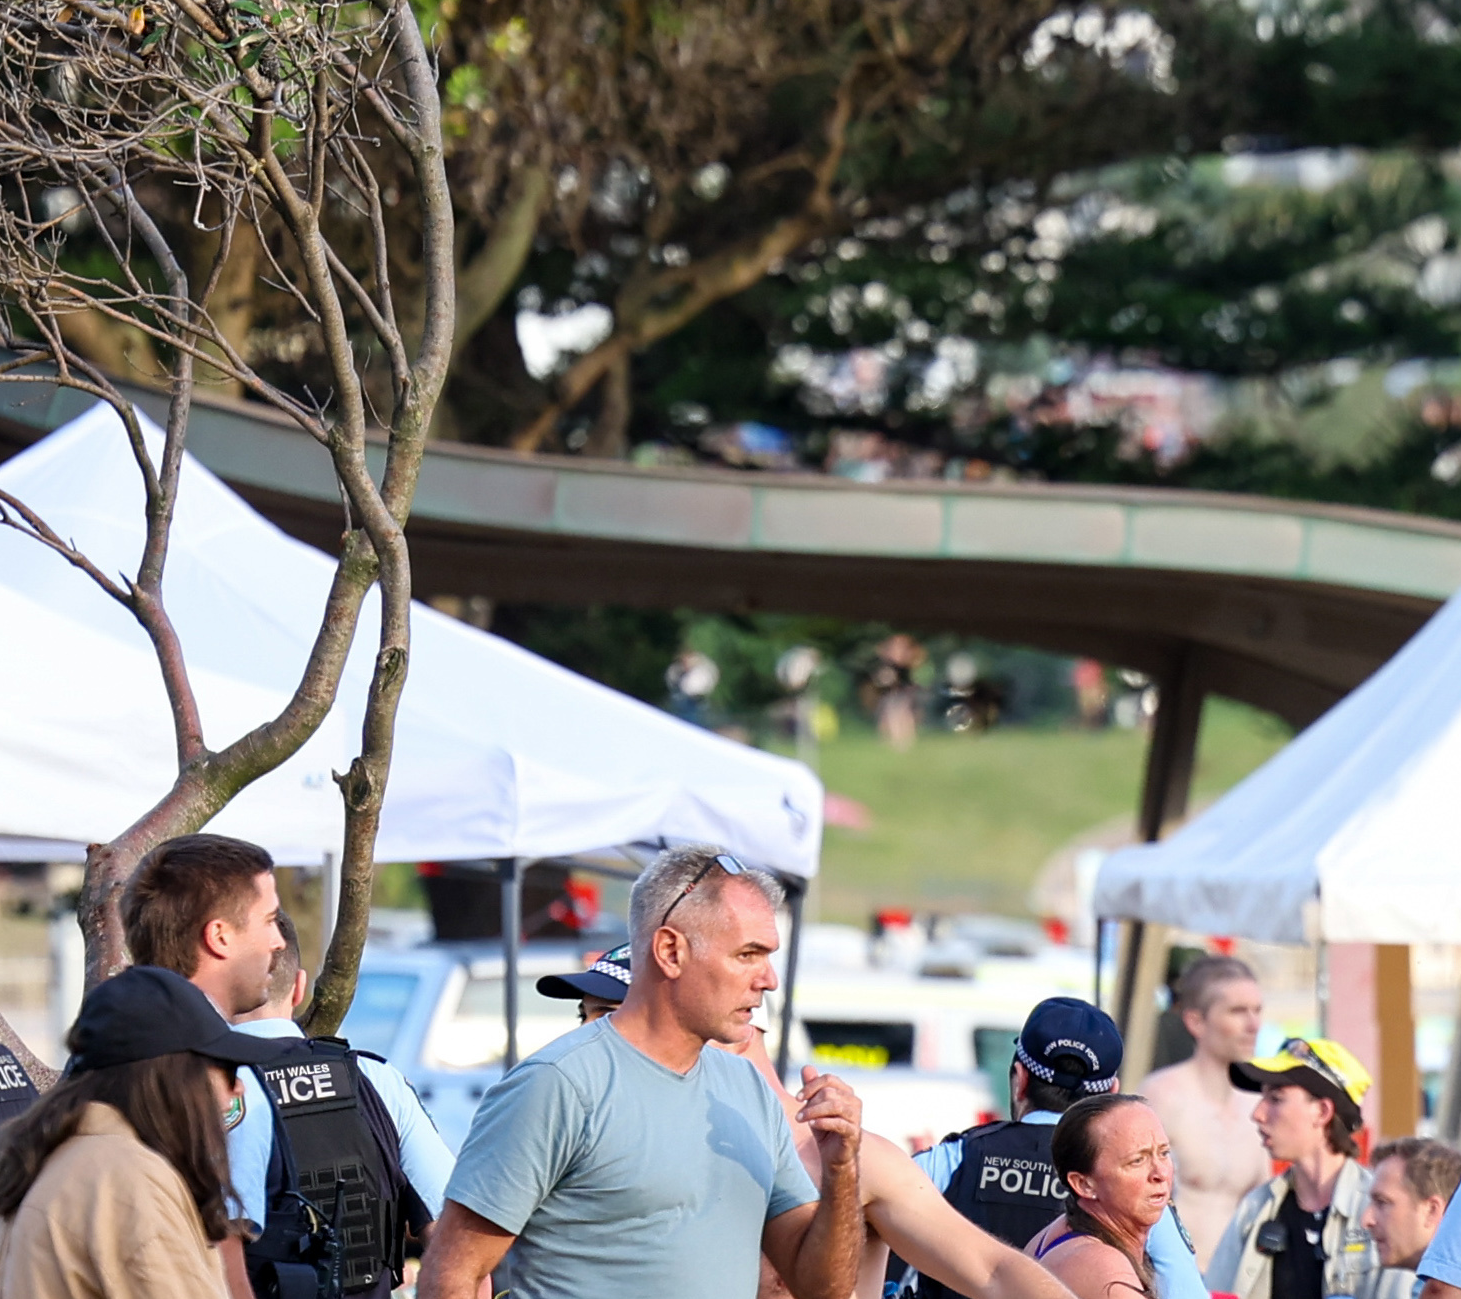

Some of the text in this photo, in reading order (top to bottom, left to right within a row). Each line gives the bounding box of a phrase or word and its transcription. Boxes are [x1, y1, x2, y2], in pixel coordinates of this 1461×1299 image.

[1058, 1038, 1086, 1051] POLICE
[287, 1063, 331, 1078] WALES
[983, 1155, 1053, 1174] NEW SOUTH
[979, 1166, 1070, 1200] POLIC
